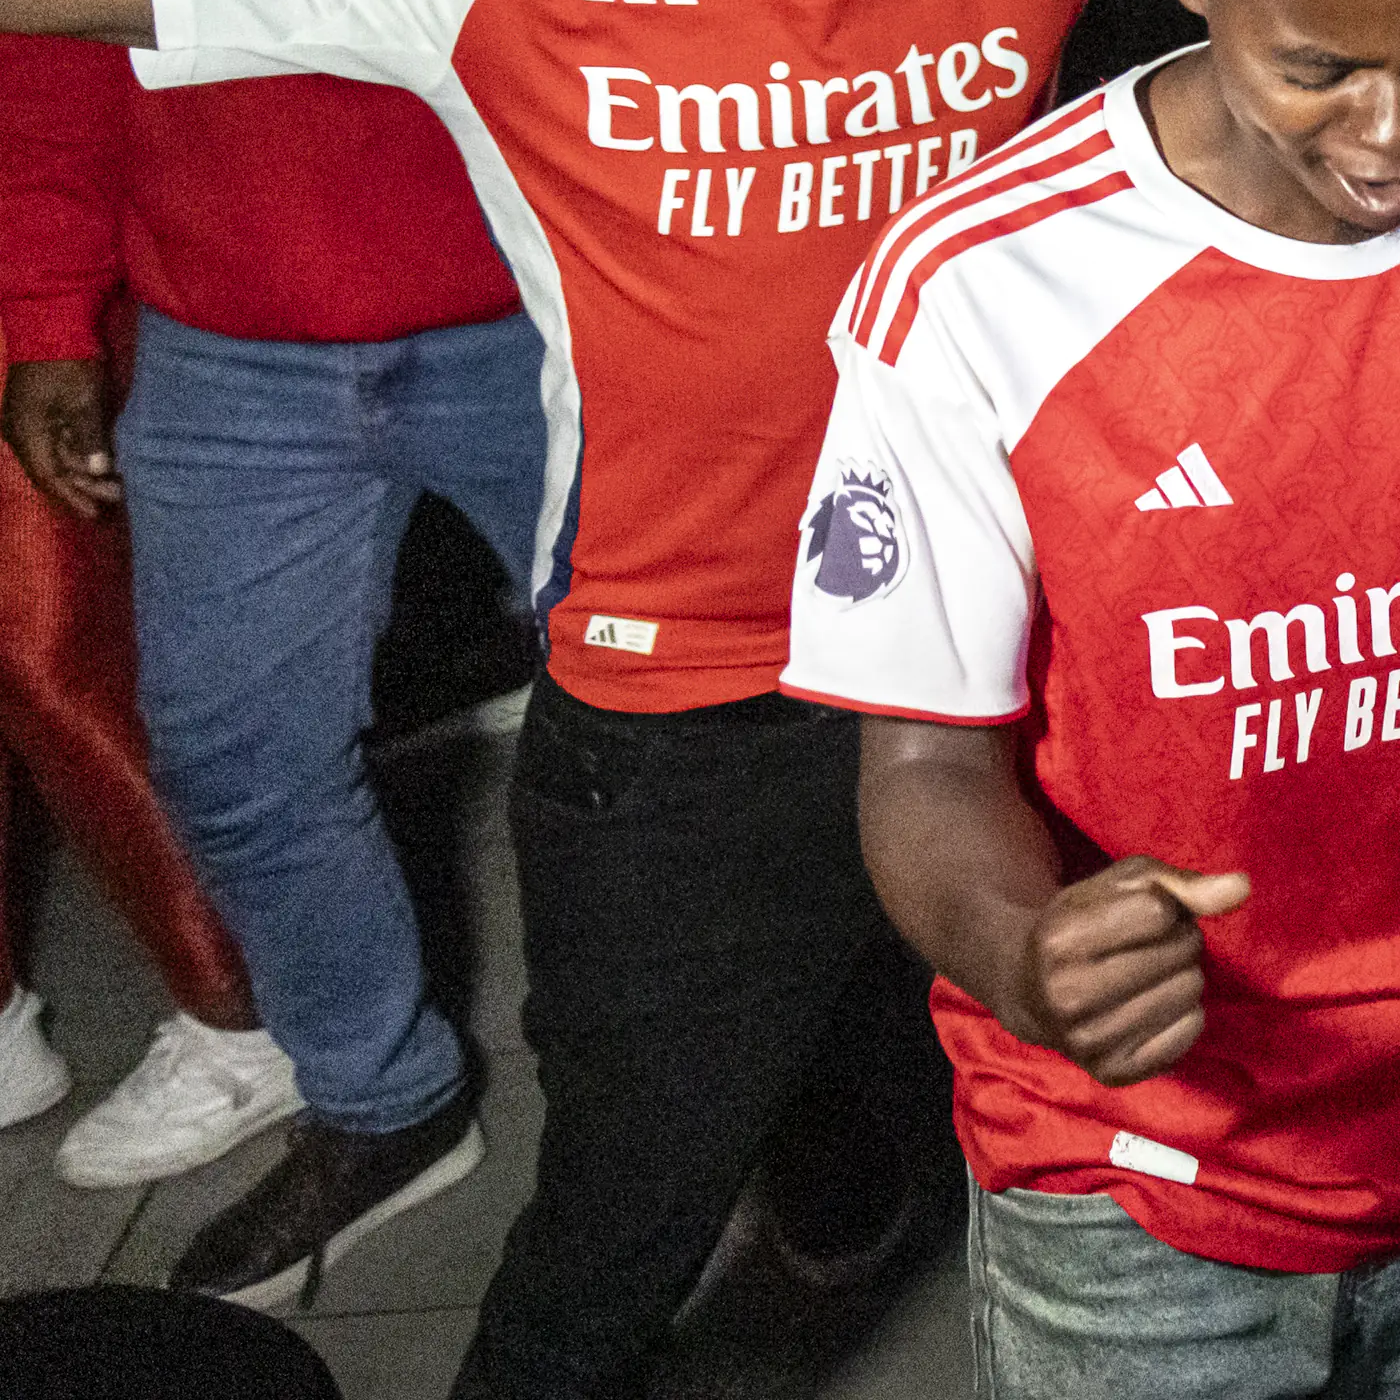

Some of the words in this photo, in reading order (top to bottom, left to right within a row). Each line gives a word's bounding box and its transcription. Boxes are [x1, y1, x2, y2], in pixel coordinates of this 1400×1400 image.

[579, 27, 1029, 154] Emirates
[657, 167, 757, 237] FLY
[1229, 688, 1324, 780] FLY
